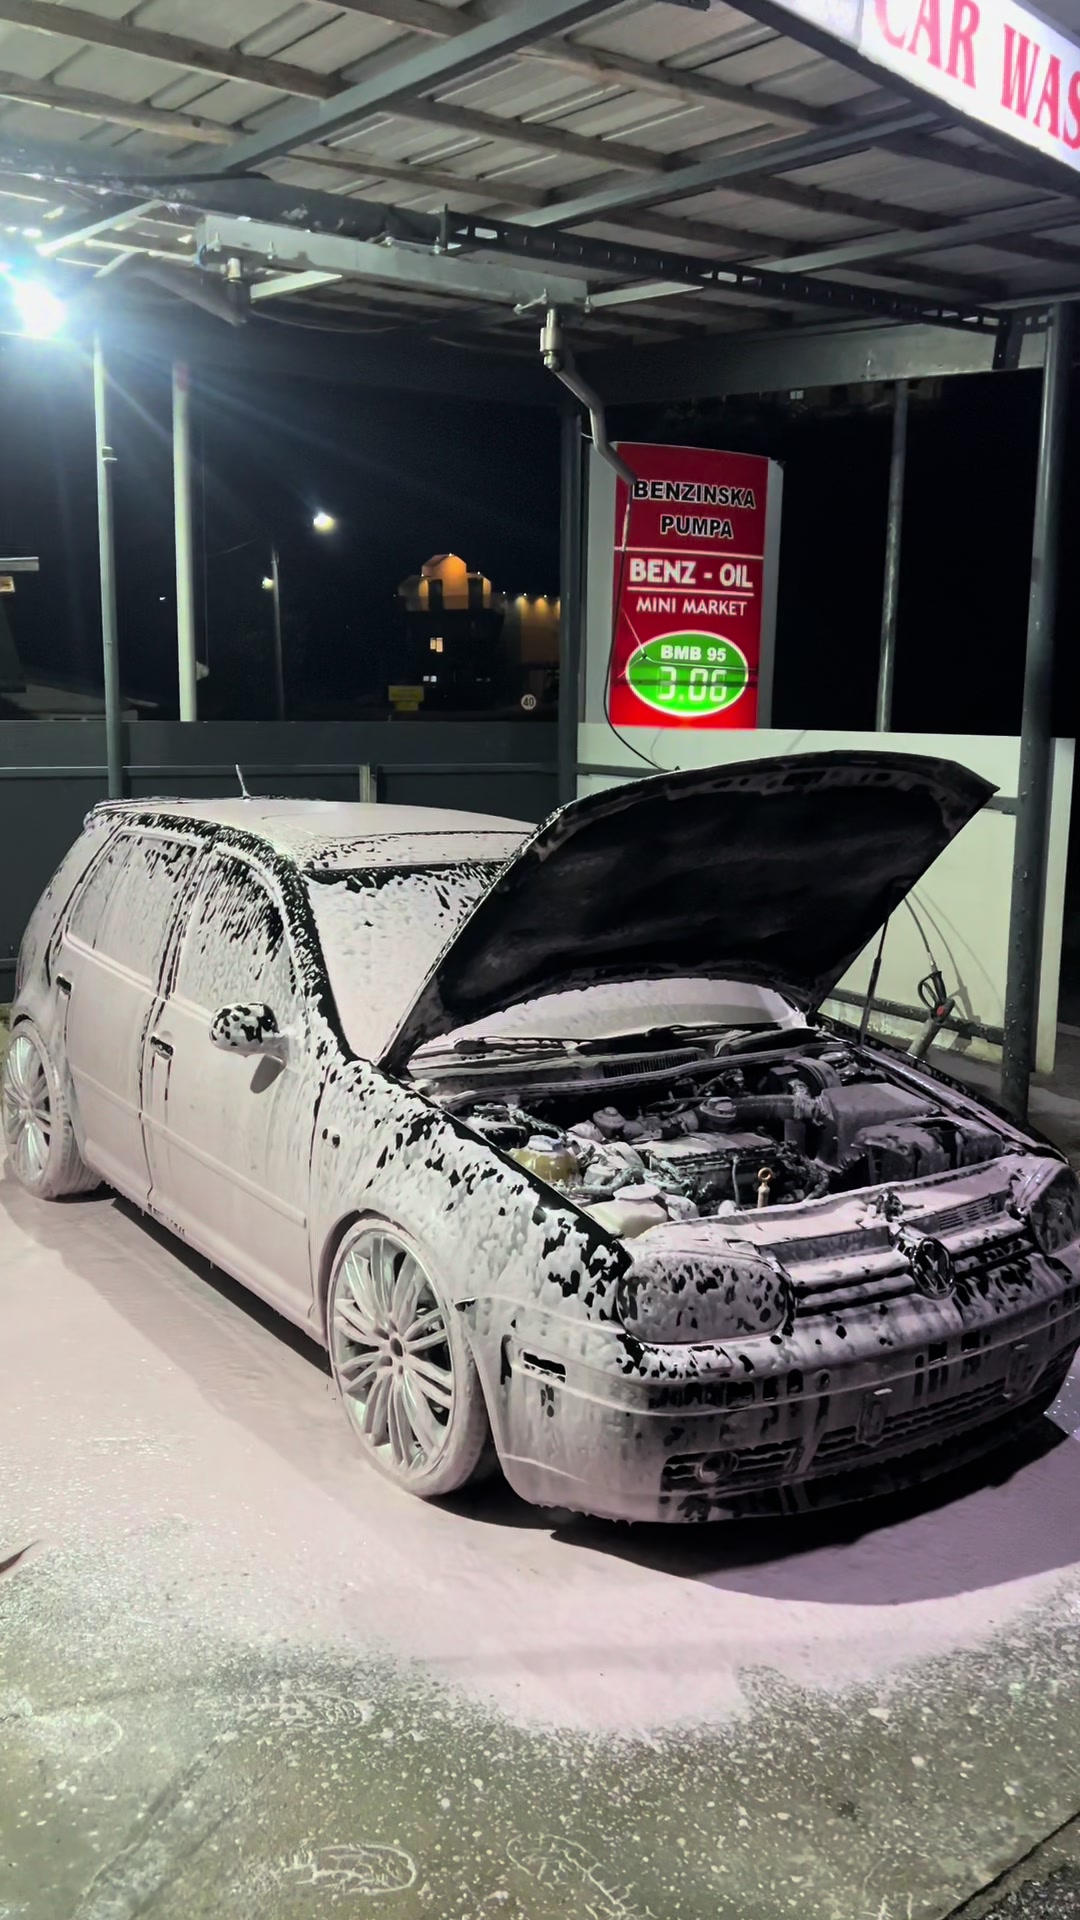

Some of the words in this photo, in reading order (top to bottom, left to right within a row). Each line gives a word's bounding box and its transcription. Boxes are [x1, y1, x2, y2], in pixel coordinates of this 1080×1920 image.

[632, 479, 756, 509] BENZINSKA
[660, 514, 734, 539] PUMPA
[630, 558, 696, 585] BENZ
[719, 563, 753, 588] OIL
[636, 597, 676, 613] MINI
[682, 599, 747, 616] MARKET
[660, 644, 702, 660] BMB
[707, 647, 727, 662] 95
[658, 666, 727, 702] 3.06
[523, 697, 535, 707] 40
